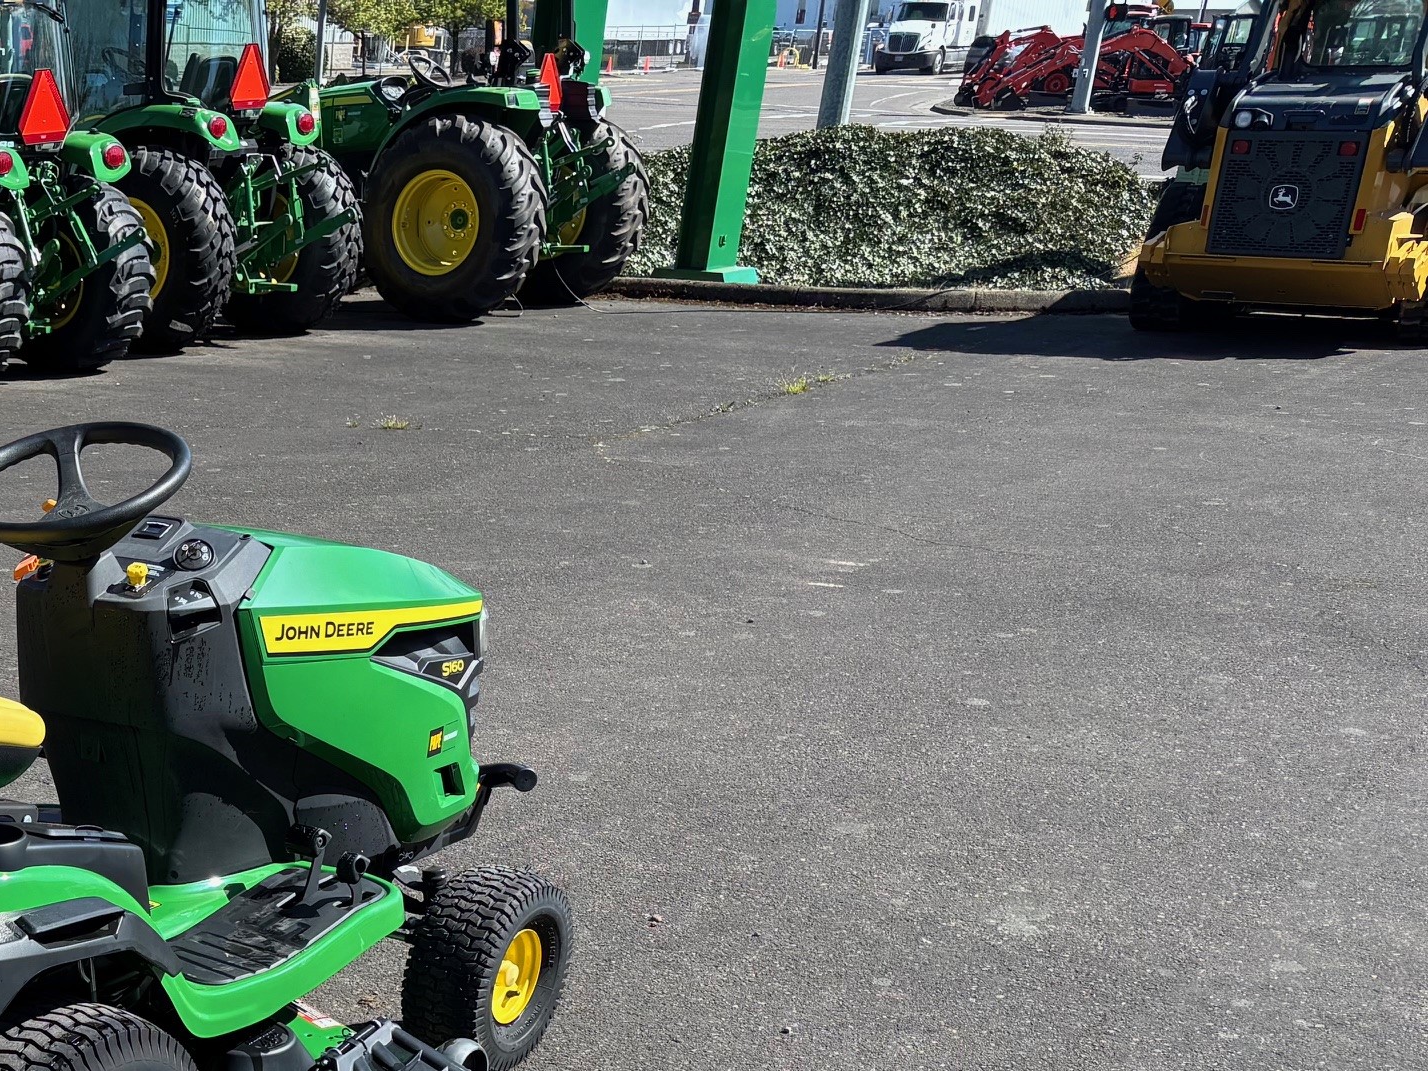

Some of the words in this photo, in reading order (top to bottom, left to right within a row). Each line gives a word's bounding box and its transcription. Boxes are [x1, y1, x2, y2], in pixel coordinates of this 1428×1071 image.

[274, 623, 320, 641] JOHN
[325, 621, 375, 638] DEERE
[441, 659, 465, 677] S160
